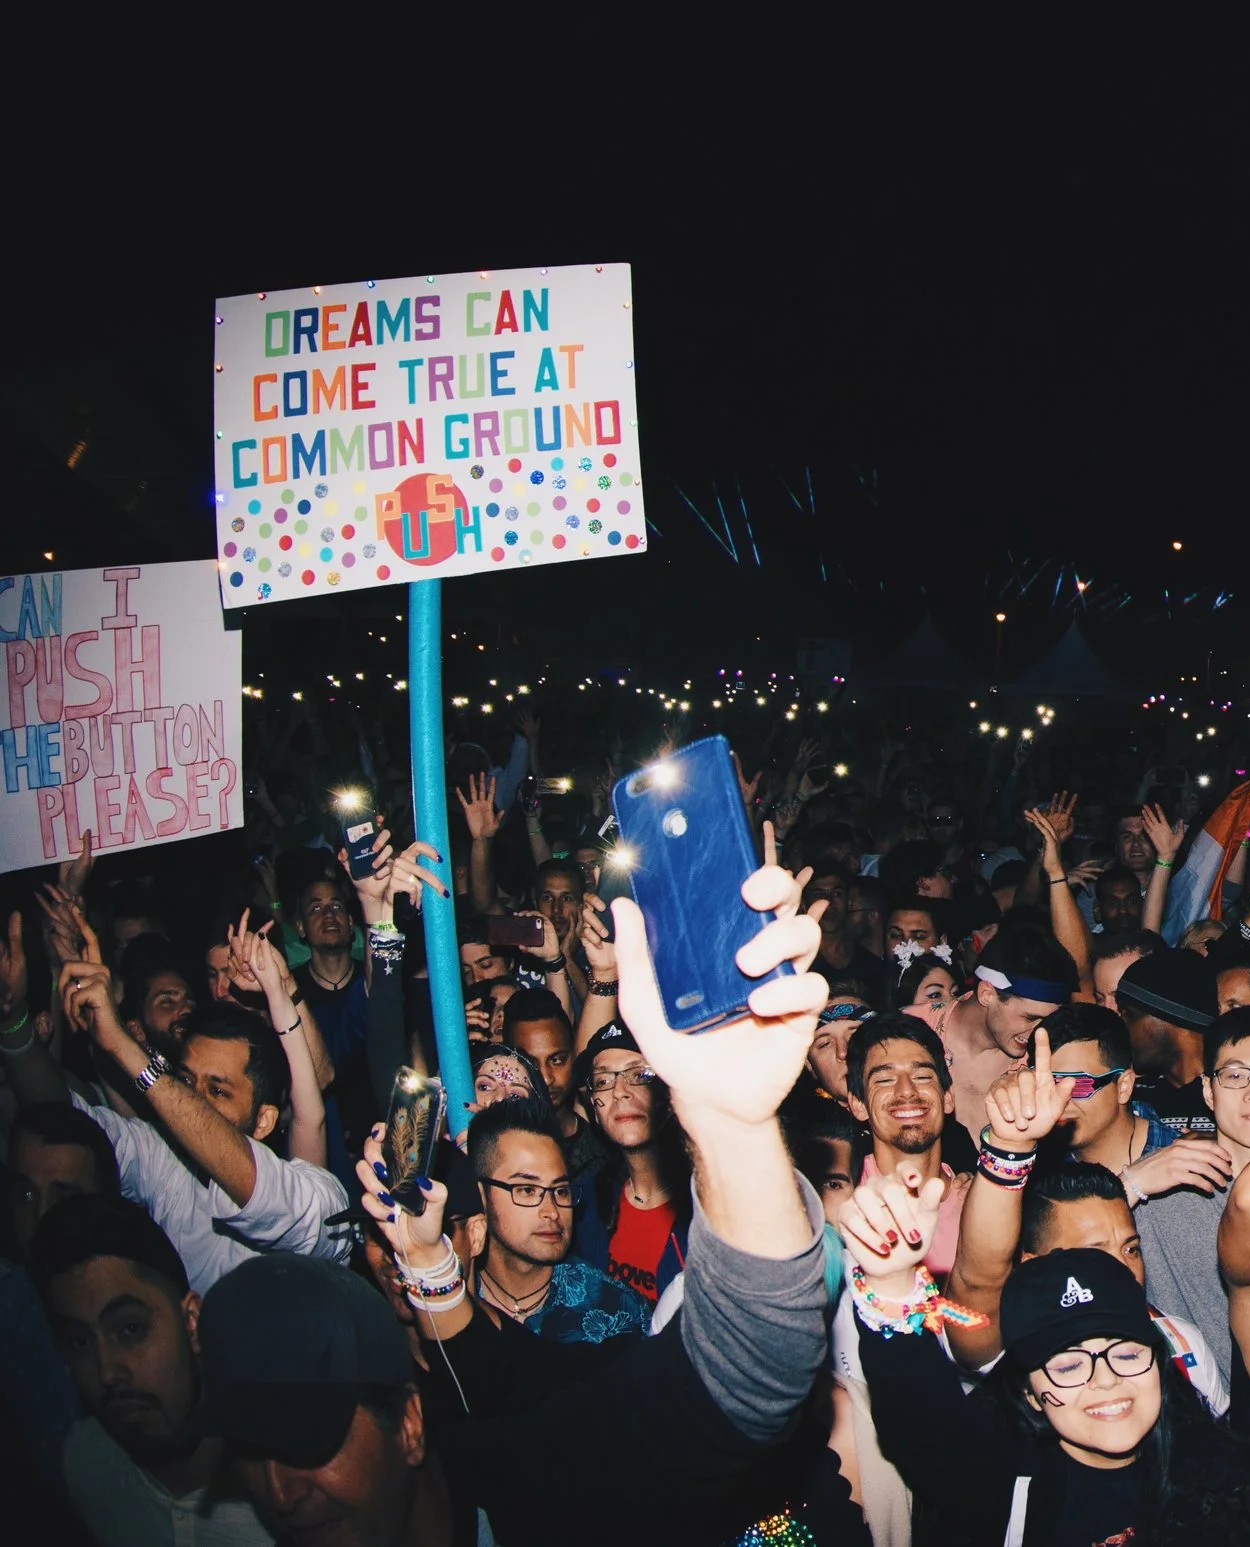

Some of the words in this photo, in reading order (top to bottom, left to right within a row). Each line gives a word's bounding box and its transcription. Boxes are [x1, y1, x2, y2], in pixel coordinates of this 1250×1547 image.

[265, 295, 440, 357] DREAMS
[466, 288, 549, 337] CAN
[253, 363, 376, 421] COME
[399, 351, 515, 404] TRUE
[534, 344, 584, 392] AT
[232, 418, 424, 489] COMMON
[445, 400, 621, 460] GROUND
[375, 474, 483, 561] PUSH
[0, 574, 62, 642] CAN
[101, 567, 140, 630] I
[6, 624, 161, 729] PUSH
[0, 721, 61, 793] HE
[63, 700, 224, 784] BUTTON
[37, 758, 236, 858] PLEASE?
